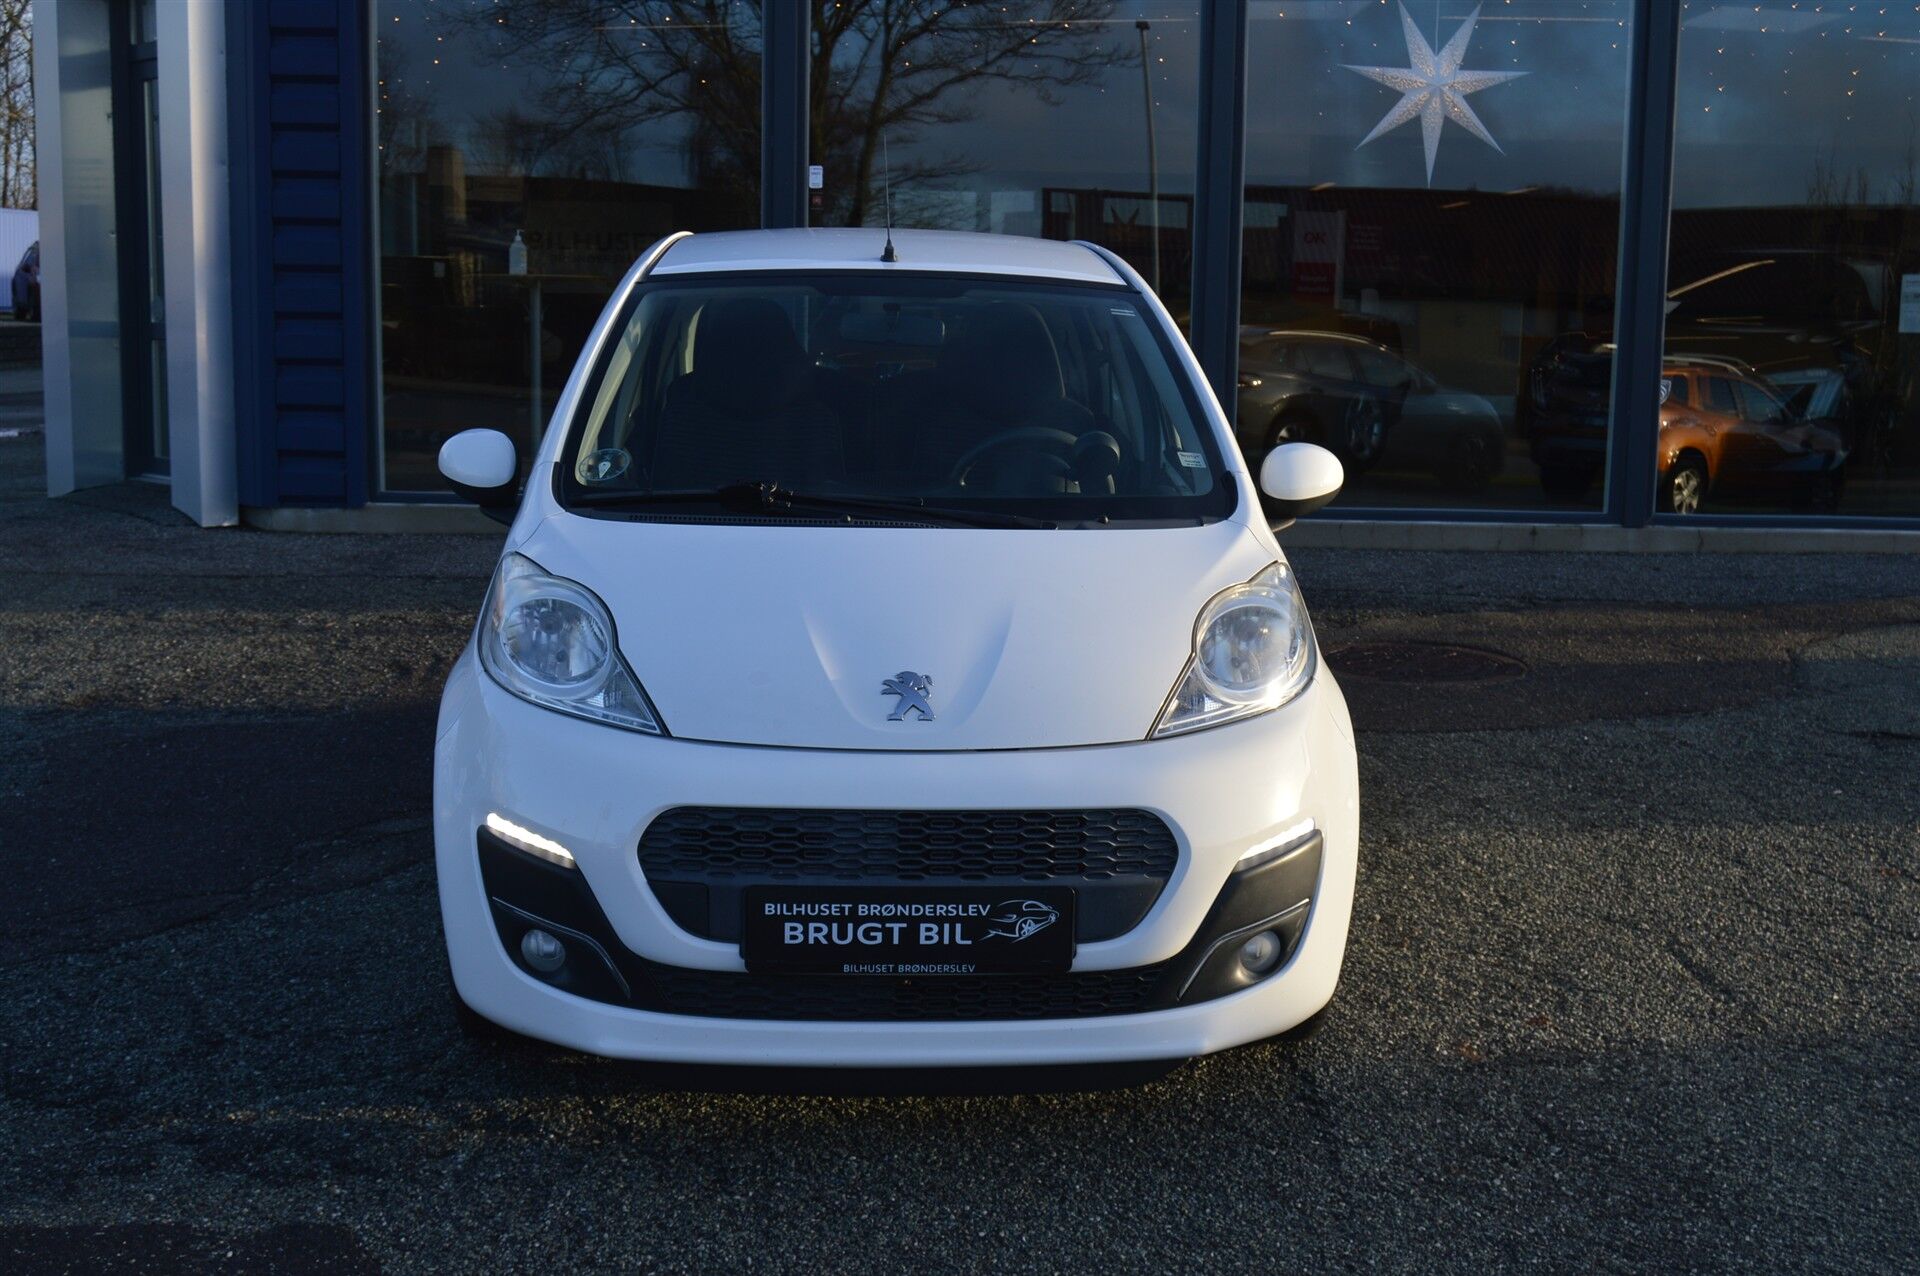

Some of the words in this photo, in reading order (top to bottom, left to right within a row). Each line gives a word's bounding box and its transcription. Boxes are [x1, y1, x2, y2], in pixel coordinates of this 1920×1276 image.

[764, 903, 852, 916] BILHUSET
[857, 902, 990, 916] BRØNDERSLEV
[784, 922, 907, 945] BRUGT
[919, 922, 972, 945] BIL
[843, 964, 894, 973] BILHUSET
[897, 964, 975, 973] BRØNDERSLEV
